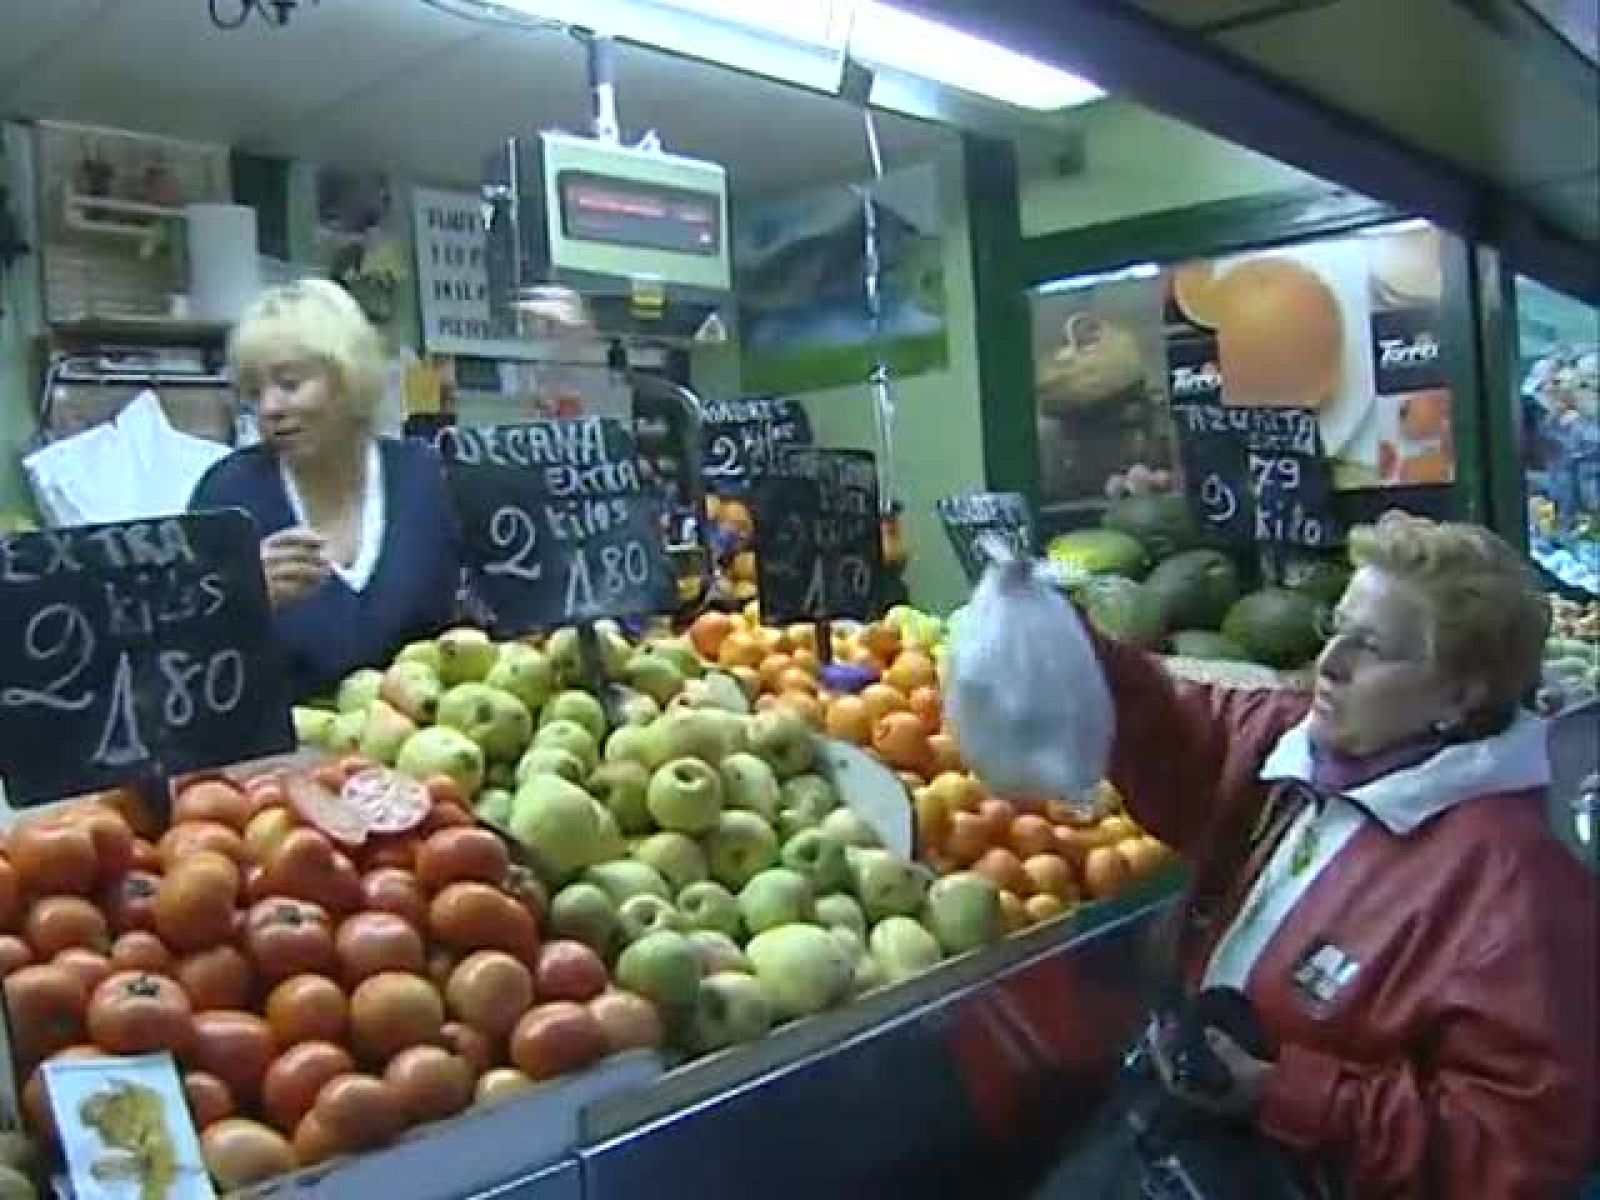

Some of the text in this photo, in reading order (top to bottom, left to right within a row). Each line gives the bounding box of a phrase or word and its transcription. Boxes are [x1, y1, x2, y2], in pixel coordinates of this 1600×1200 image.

[701, 436, 746, 477] 2
[1250, 453, 1300, 496] 79
[3, 519, 195, 583] EXTRA
[482, 504, 542, 580] 2
[1254, 503, 1322, 546] kilo
[1, 602, 95, 711] 2
